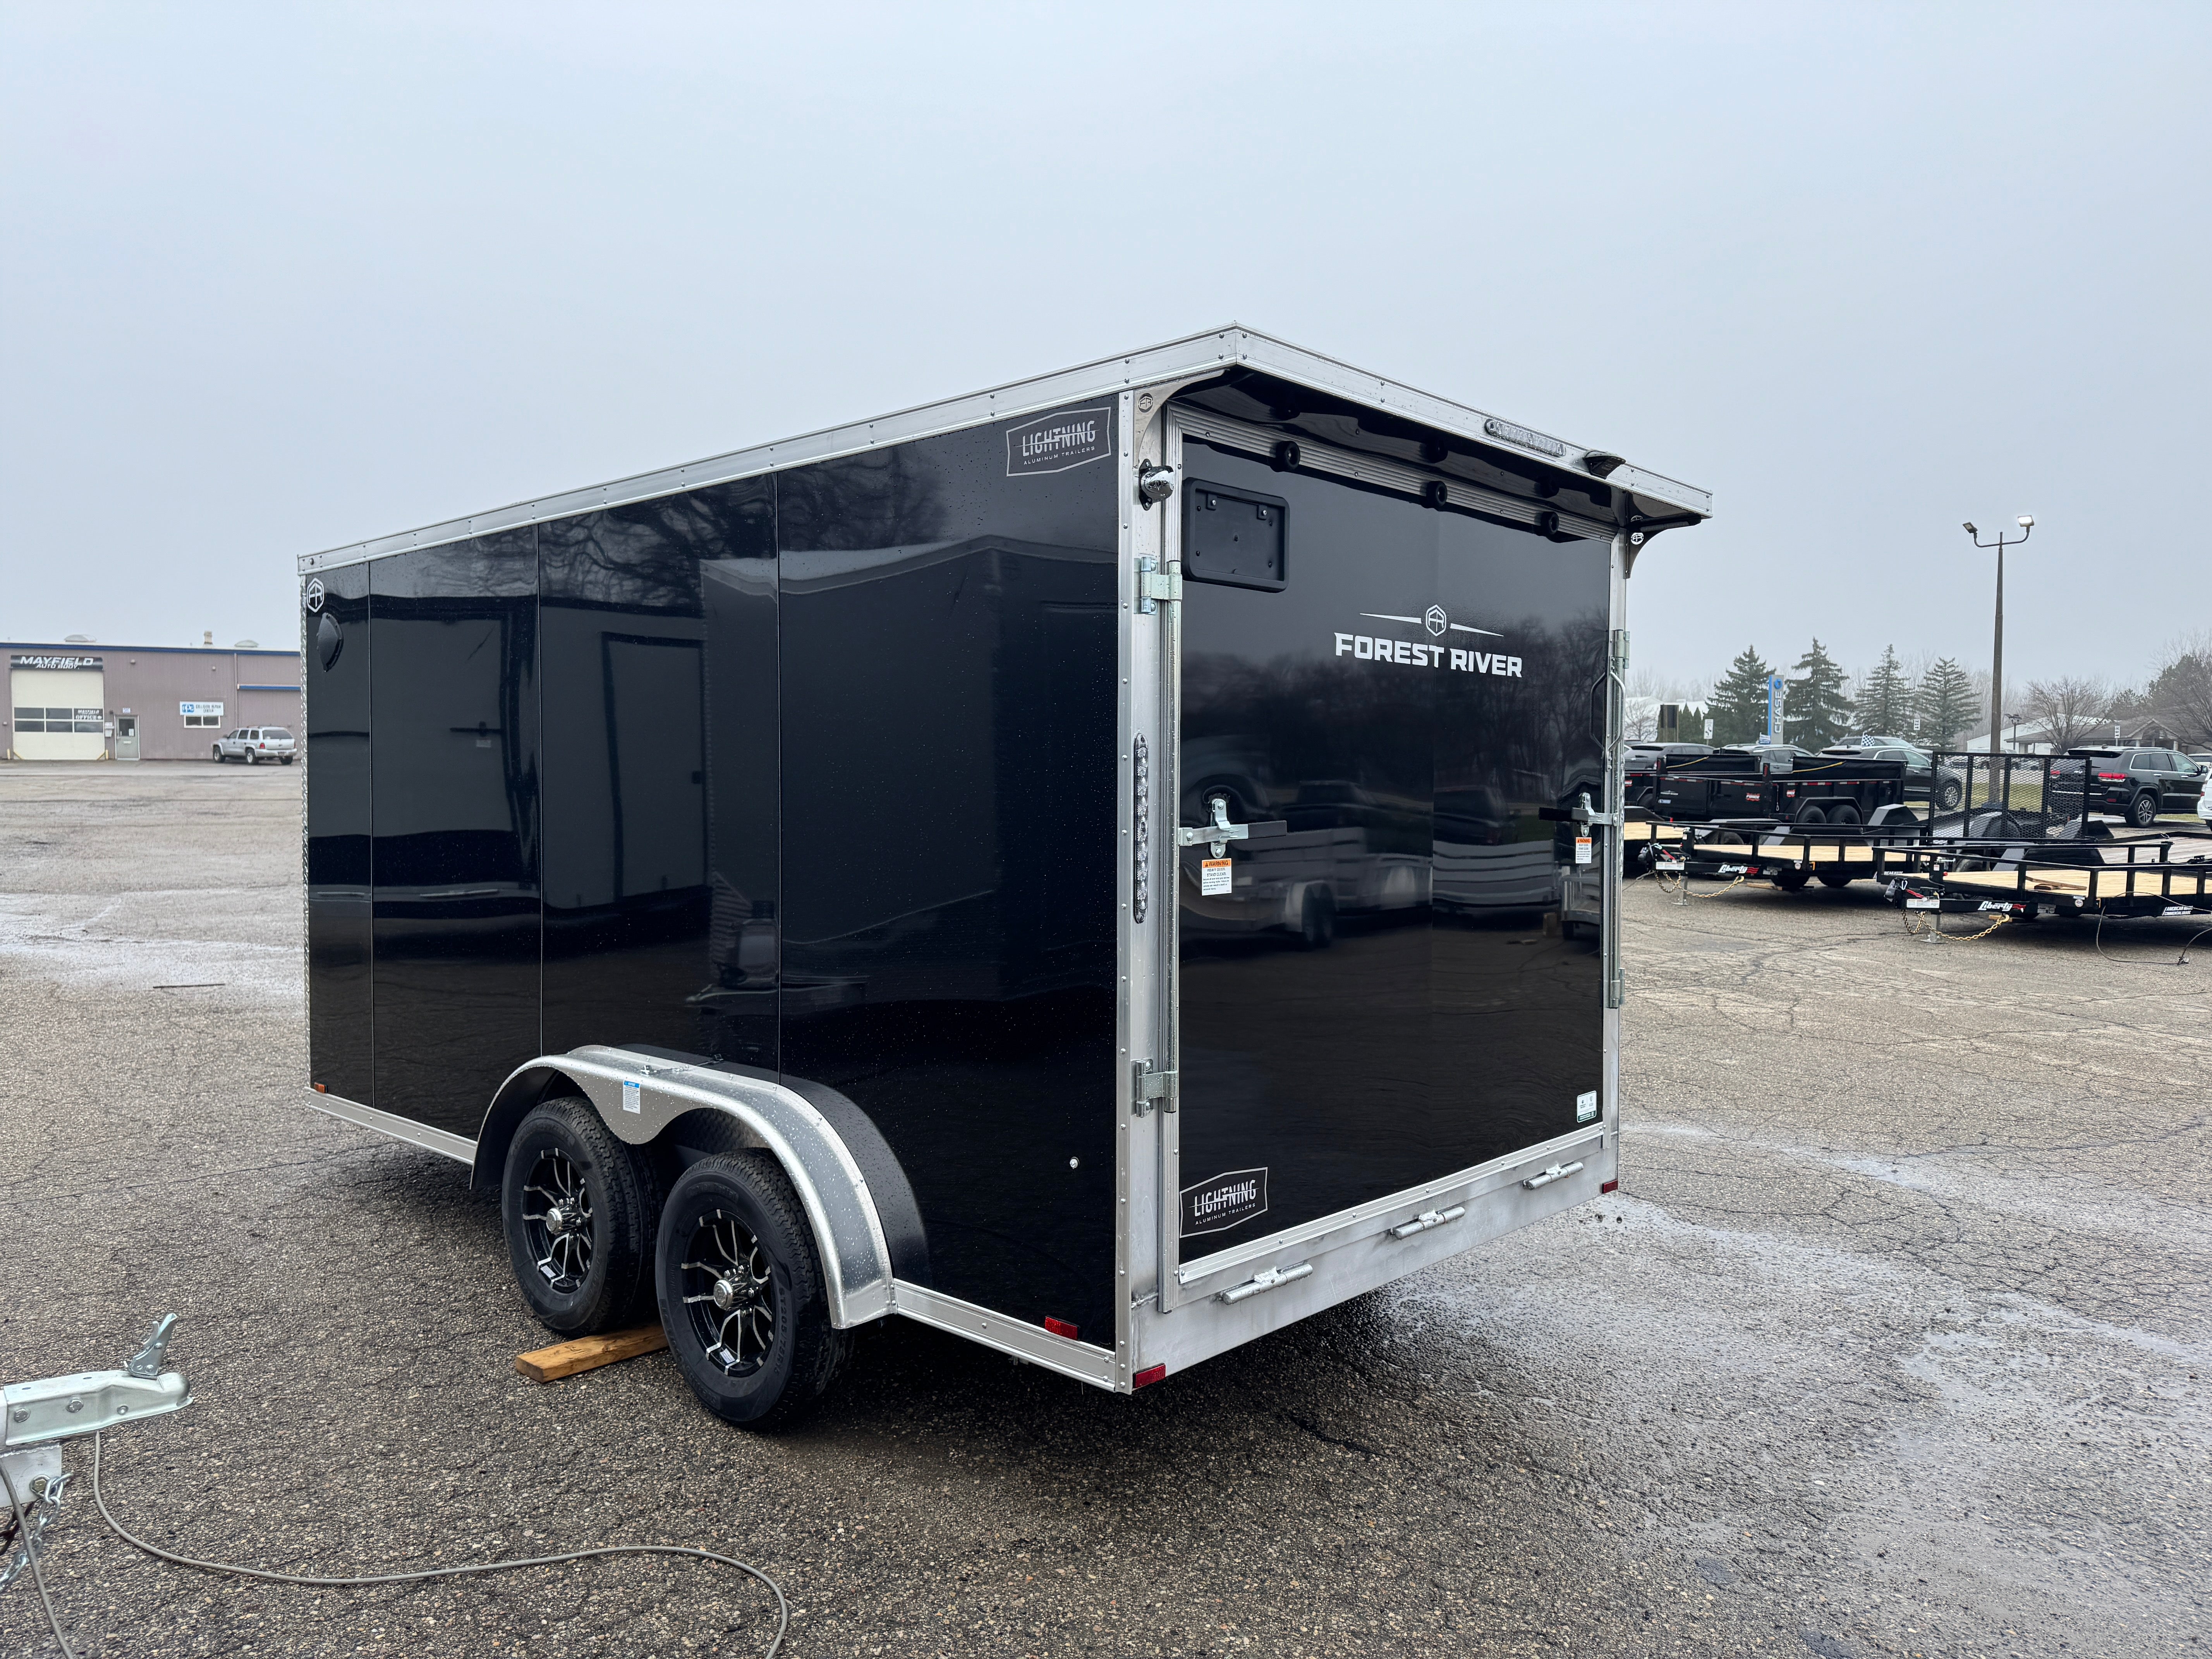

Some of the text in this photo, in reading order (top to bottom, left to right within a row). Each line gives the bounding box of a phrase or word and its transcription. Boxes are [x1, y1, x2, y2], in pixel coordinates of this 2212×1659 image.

[1022, 420, 1096, 457] LIGHTNING
[1024, 446, 1095, 465] ALUMINUM TRAILERS
[20, 656, 94, 666] MAYFIELD
[1334, 632, 1523, 678] FOREST RIVER
[1718, 864, 1748, 874] Liberty
[1978, 901, 2013, 912] Liberty
[1194, 1179, 1256, 1217] LIGHTNING
[1195, 1203, 1256, 1225] ALUMINUM TRAILERS
